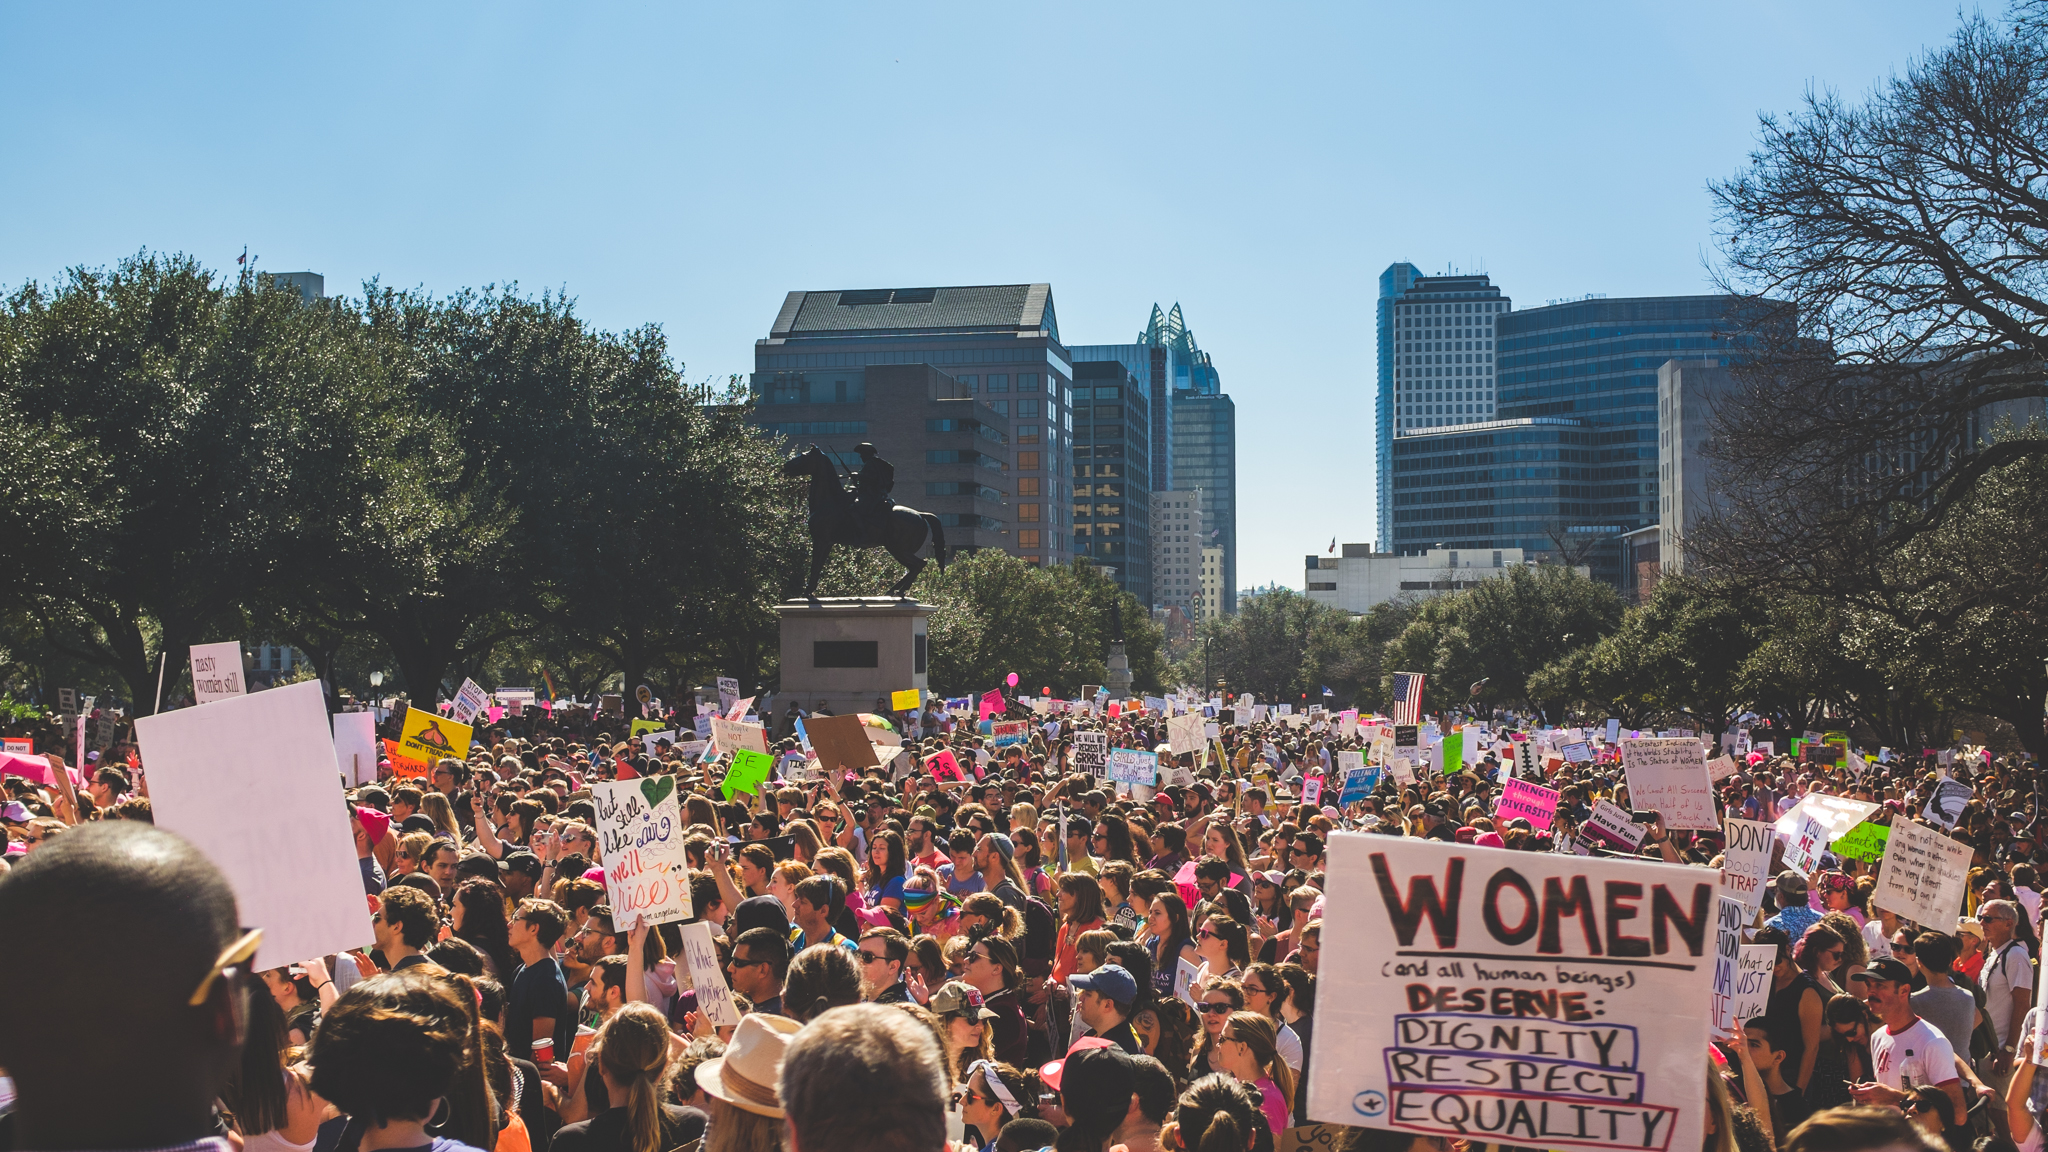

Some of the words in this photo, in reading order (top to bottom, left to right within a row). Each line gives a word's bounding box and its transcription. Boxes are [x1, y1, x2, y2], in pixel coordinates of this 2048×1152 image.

[195, 654, 216, 678] nasty
[196, 679, 224, 694] women
[224, 672, 240, 694] still
[467, 681, 483, 697] STOP
[727, 732, 742, 742] NOT
[1083, 734, 1096, 743] WILL
[1096, 735, 1106, 744] NOT
[1624, 740, 1638, 749] The
[1638, 740, 1663, 748] Greatest
[1665, 739, 1698, 747] Indicator
[425, 746, 443, 757] TREAD
[1075, 751, 1106, 766] GRRRLS
[1112, 751, 1136, 764] GIRLS
[1135, 755, 1152, 766] just
[1633, 749, 1643, 757] the
[392, 758, 426, 773] FORWARD
[789, 759, 806, 770] TIME
[1133, 763, 1147, 773] have
[1627, 760, 1636, 769] Is
[1636, 757, 1648, 766] The
[1649, 756, 1669, 765] Status
[1671, 755, 1678, 764] of
[1680, 756, 1704, 765] WOMEN
[1122, 769, 1138, 777] FUN
[1349, 768, 1377, 779] SILENCE
[1507, 778, 1559, 802] STRENGTH
[1633, 783, 1646, 796] We
[1666, 783, 1678, 794] All
[1680, 784, 1708, 795] Succeed
[1512, 790, 1545, 807] through
[1635, 797, 1657, 810] When
[1660, 796, 1677, 809] Half
[1680, 798, 1690, 809] of
[1694, 800, 1703, 811] Us
[1501, 797, 1553, 820] DIVERSITY
[1676, 810, 1700, 821] Back
[1599, 803, 1614, 815] Girls
[1612, 811, 1625, 821] Just
[1625, 817, 1645, 832] Wanna
[1593, 813, 1618, 831] Have
[1618, 827, 1639, 842] Fun-
[603, 828, 634, 857] like
[1728, 821, 1776, 854] DON'T
[1841, 834, 1872, 849] lanet
[1906, 830, 1917, 842] am
[1919, 834, 1933, 846] not
[1946, 843, 1963, 856] while
[1894, 839, 1906, 854] any
[1907, 844, 1926, 856] woman
[610, 849, 643, 885] we'll
[1724, 851, 1765, 881] booby
[1892, 852, 1907, 864] even
[1909, 857, 1926, 869] when
[1927, 861, 1936, 873] her
[1727, 873, 1759, 893] TRAP
[1891, 864, 1902, 876] are
[1905, 869, 1920, 887] very
[1735, 891, 1749, 901] my
[1887, 875, 1905, 892] from
[1907, 886, 1917, 902] my
[1120, 907, 1136, 919] KEEP
[1369, 852, 1713, 958] WOMEN
[1766, 959, 1774, 971] a
[1382, 959, 1429, 979] (and
[1437, 961, 1462, 979] all
[1473, 963, 1548, 984] human
[1556, 965, 1636, 993] beings)
[1405, 984, 1606, 1022] DESERVE:
[1737, 1001, 1763, 1020] Like
[1398, 1017, 1631, 1074] DIGNITY,
[1390, 1052, 1637, 1102] RESPECT,
[1394, 1089, 1666, 1147] EQUALITY
